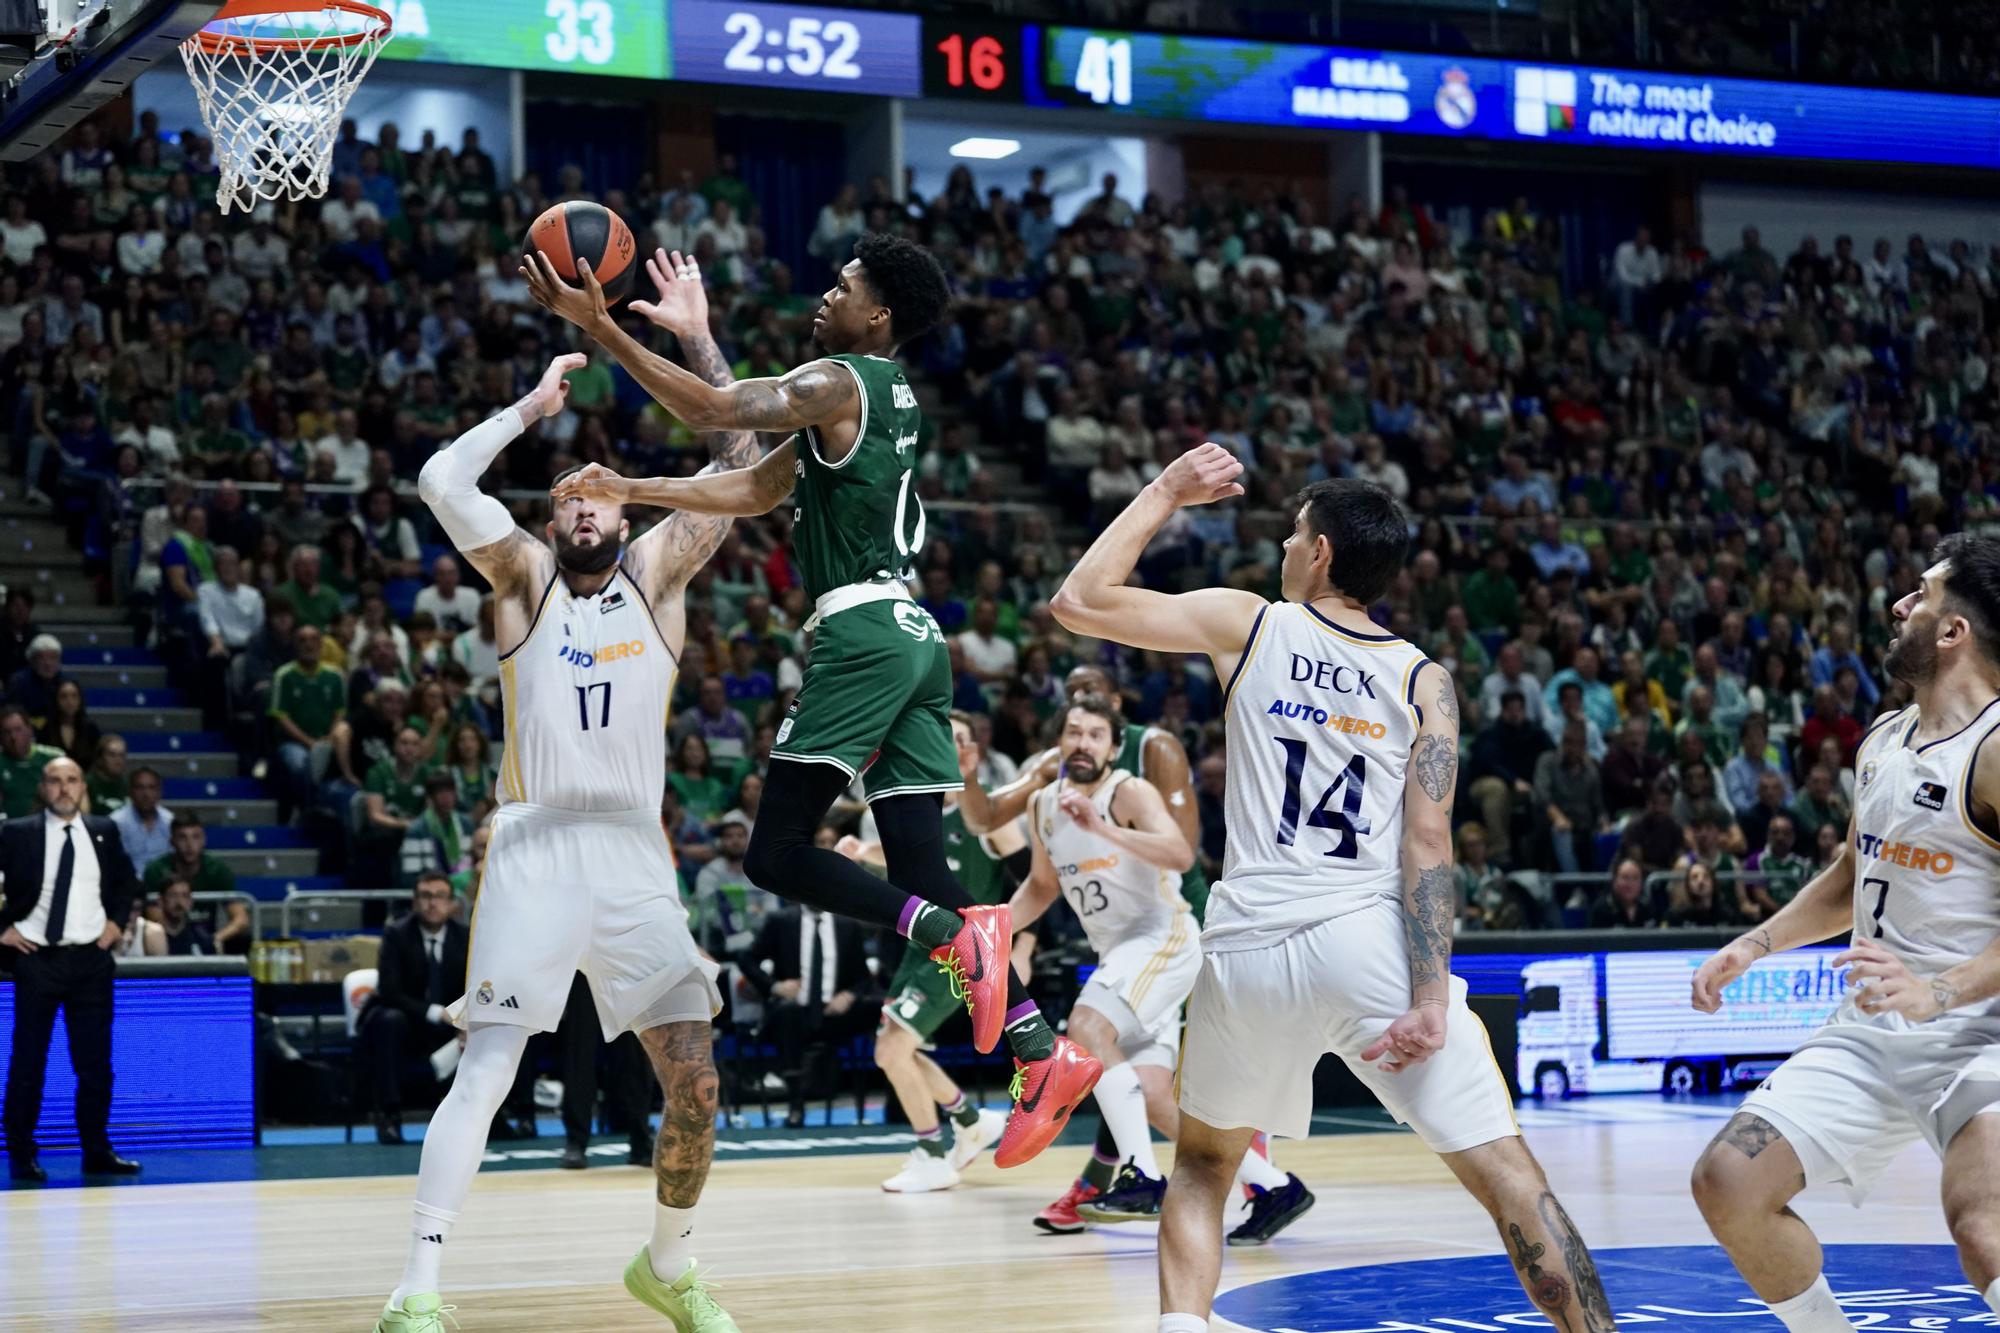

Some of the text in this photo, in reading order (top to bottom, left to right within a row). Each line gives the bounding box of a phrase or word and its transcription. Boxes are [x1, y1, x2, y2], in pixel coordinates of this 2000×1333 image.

[545, 0, 615, 65] 33
[724, 13, 862, 79] 2:52
[937, 34, 1005, 90] 16
[1076, 37, 1132, 105] 41
[1590, 73, 1713, 113] The most
[1588, 109, 1777, 147] natural choice
[1290, 652, 1377, 700] DECK
[575, 681, 611, 731] 17
[1266, 699, 1388, 740] AUTOHERO
[1273, 736, 1372, 860] 14
[1070, 880, 1109, 917] 23
[1862, 877, 1890, 939] 7
